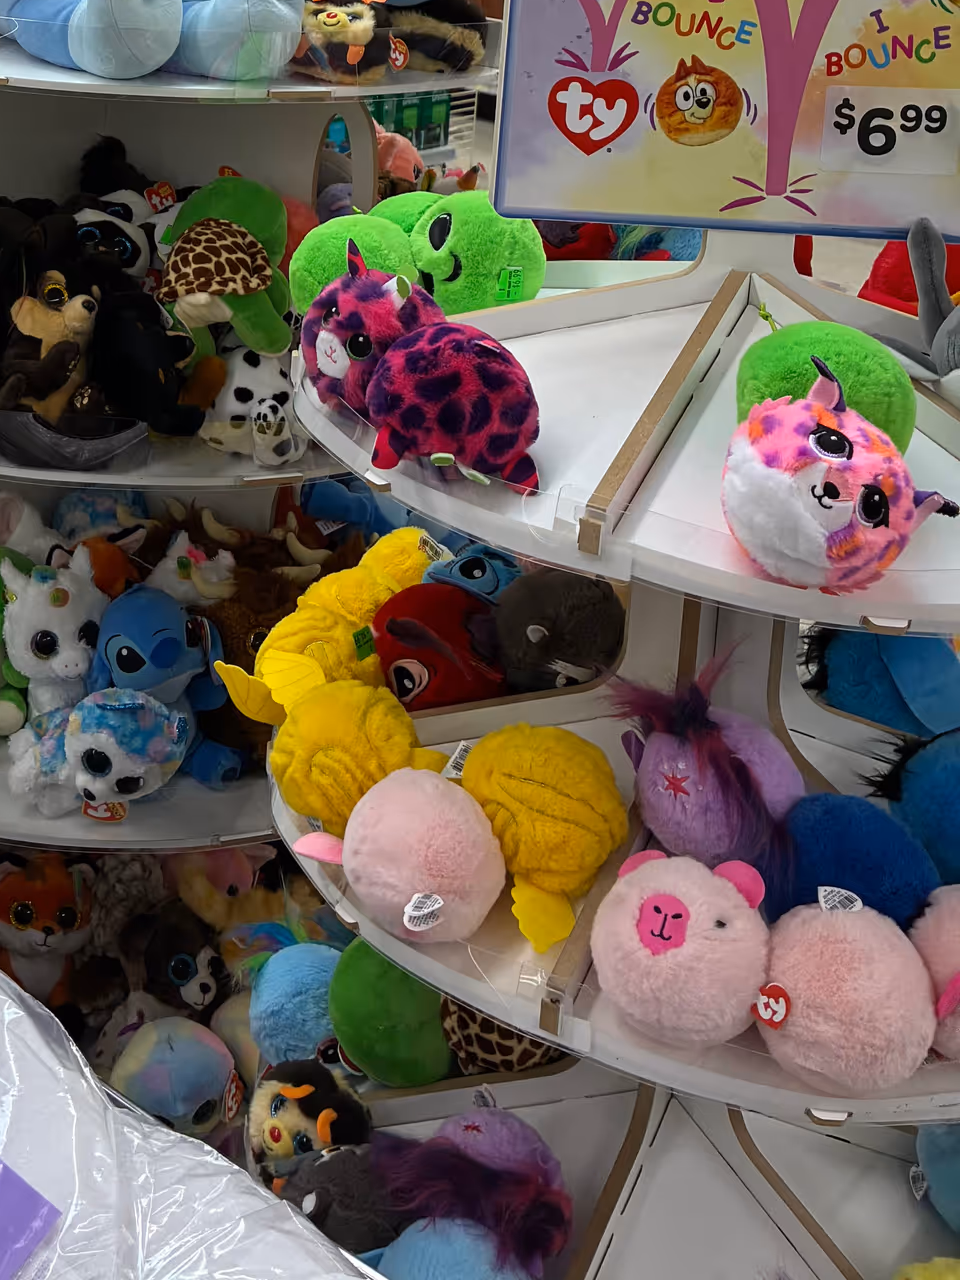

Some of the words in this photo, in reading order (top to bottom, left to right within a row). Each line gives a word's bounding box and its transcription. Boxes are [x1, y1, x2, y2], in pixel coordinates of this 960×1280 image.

[631, 0, 758, 51] BOUNCE
[869, 8, 890, 34] I
[825, 25, 952, 77] BOUNCE
[556, 82, 628, 142] ty
[757, 996, 787, 1022] ty
